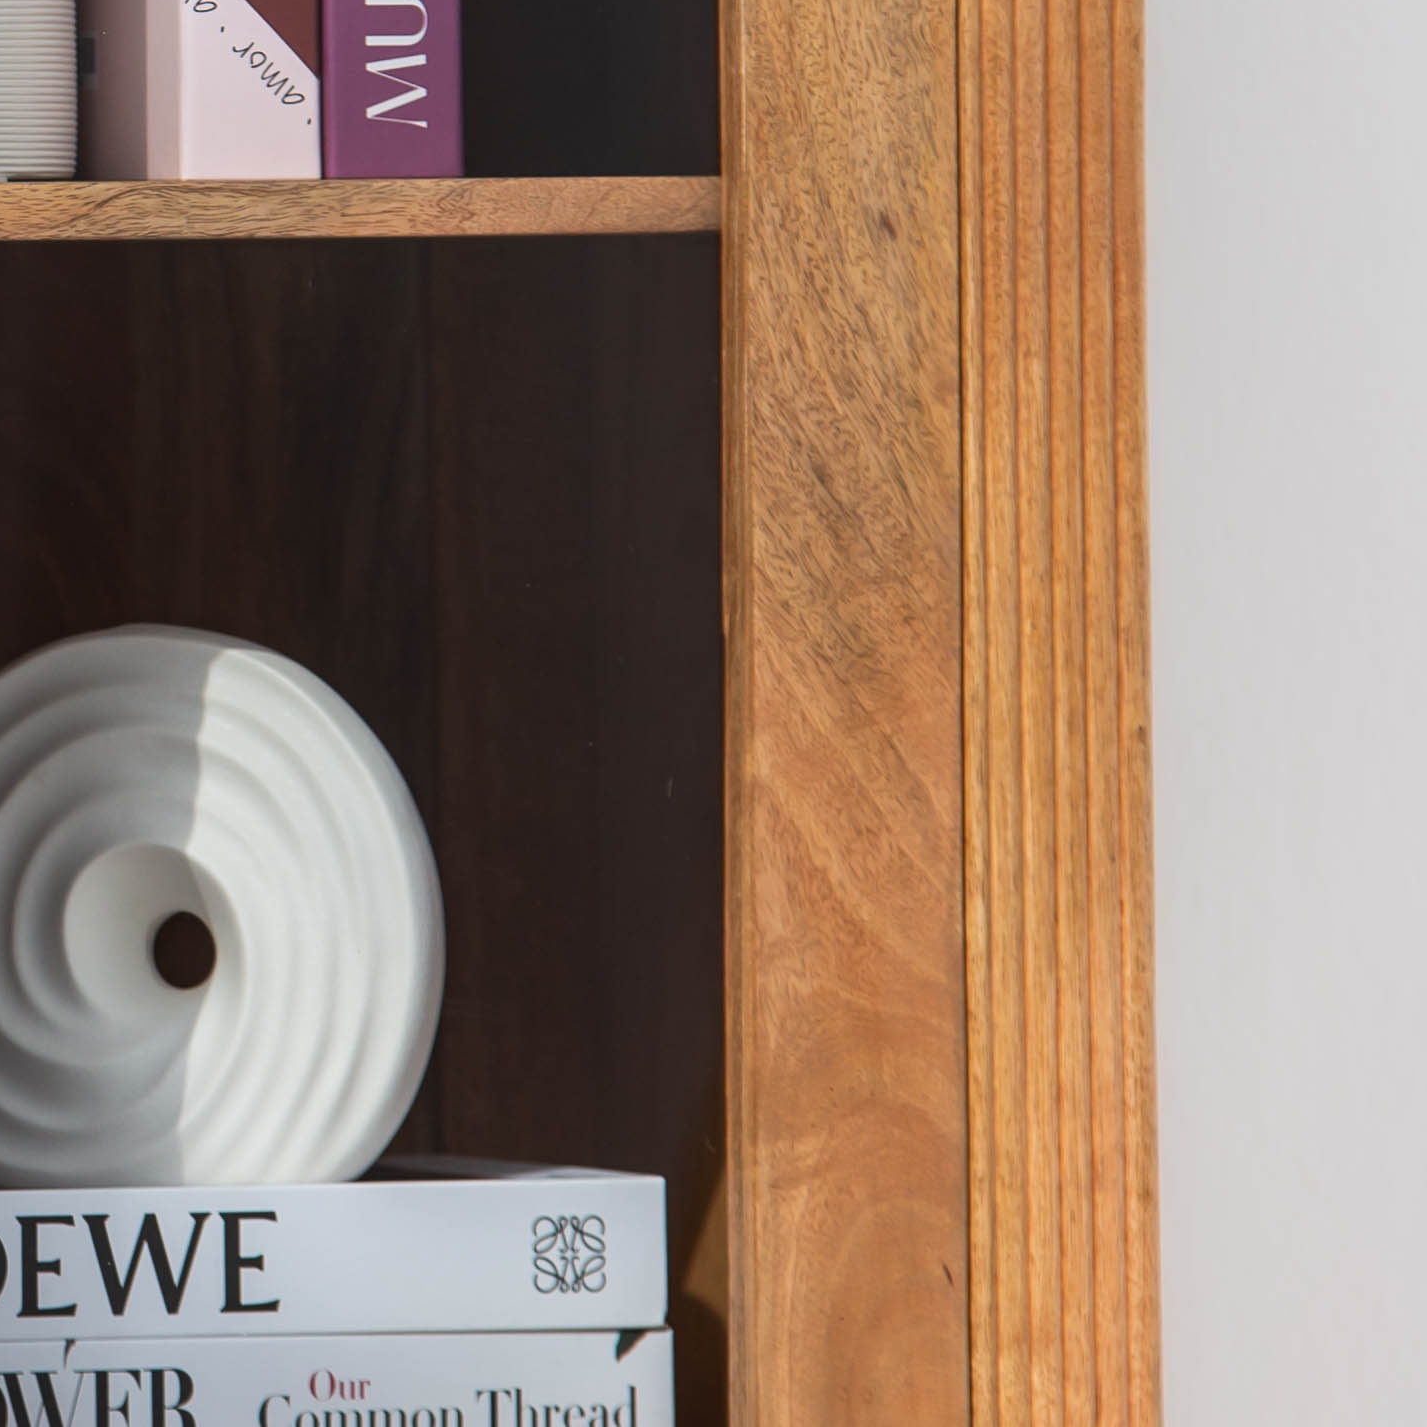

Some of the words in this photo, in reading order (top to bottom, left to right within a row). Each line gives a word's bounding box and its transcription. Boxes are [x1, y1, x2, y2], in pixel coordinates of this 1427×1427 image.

[232, 42, 306, 106] amor
[309, 1369, 372, 1401] Our
[258, 1394, 465, 1427] Common
[476, 1386, 637, 1427] Thread
